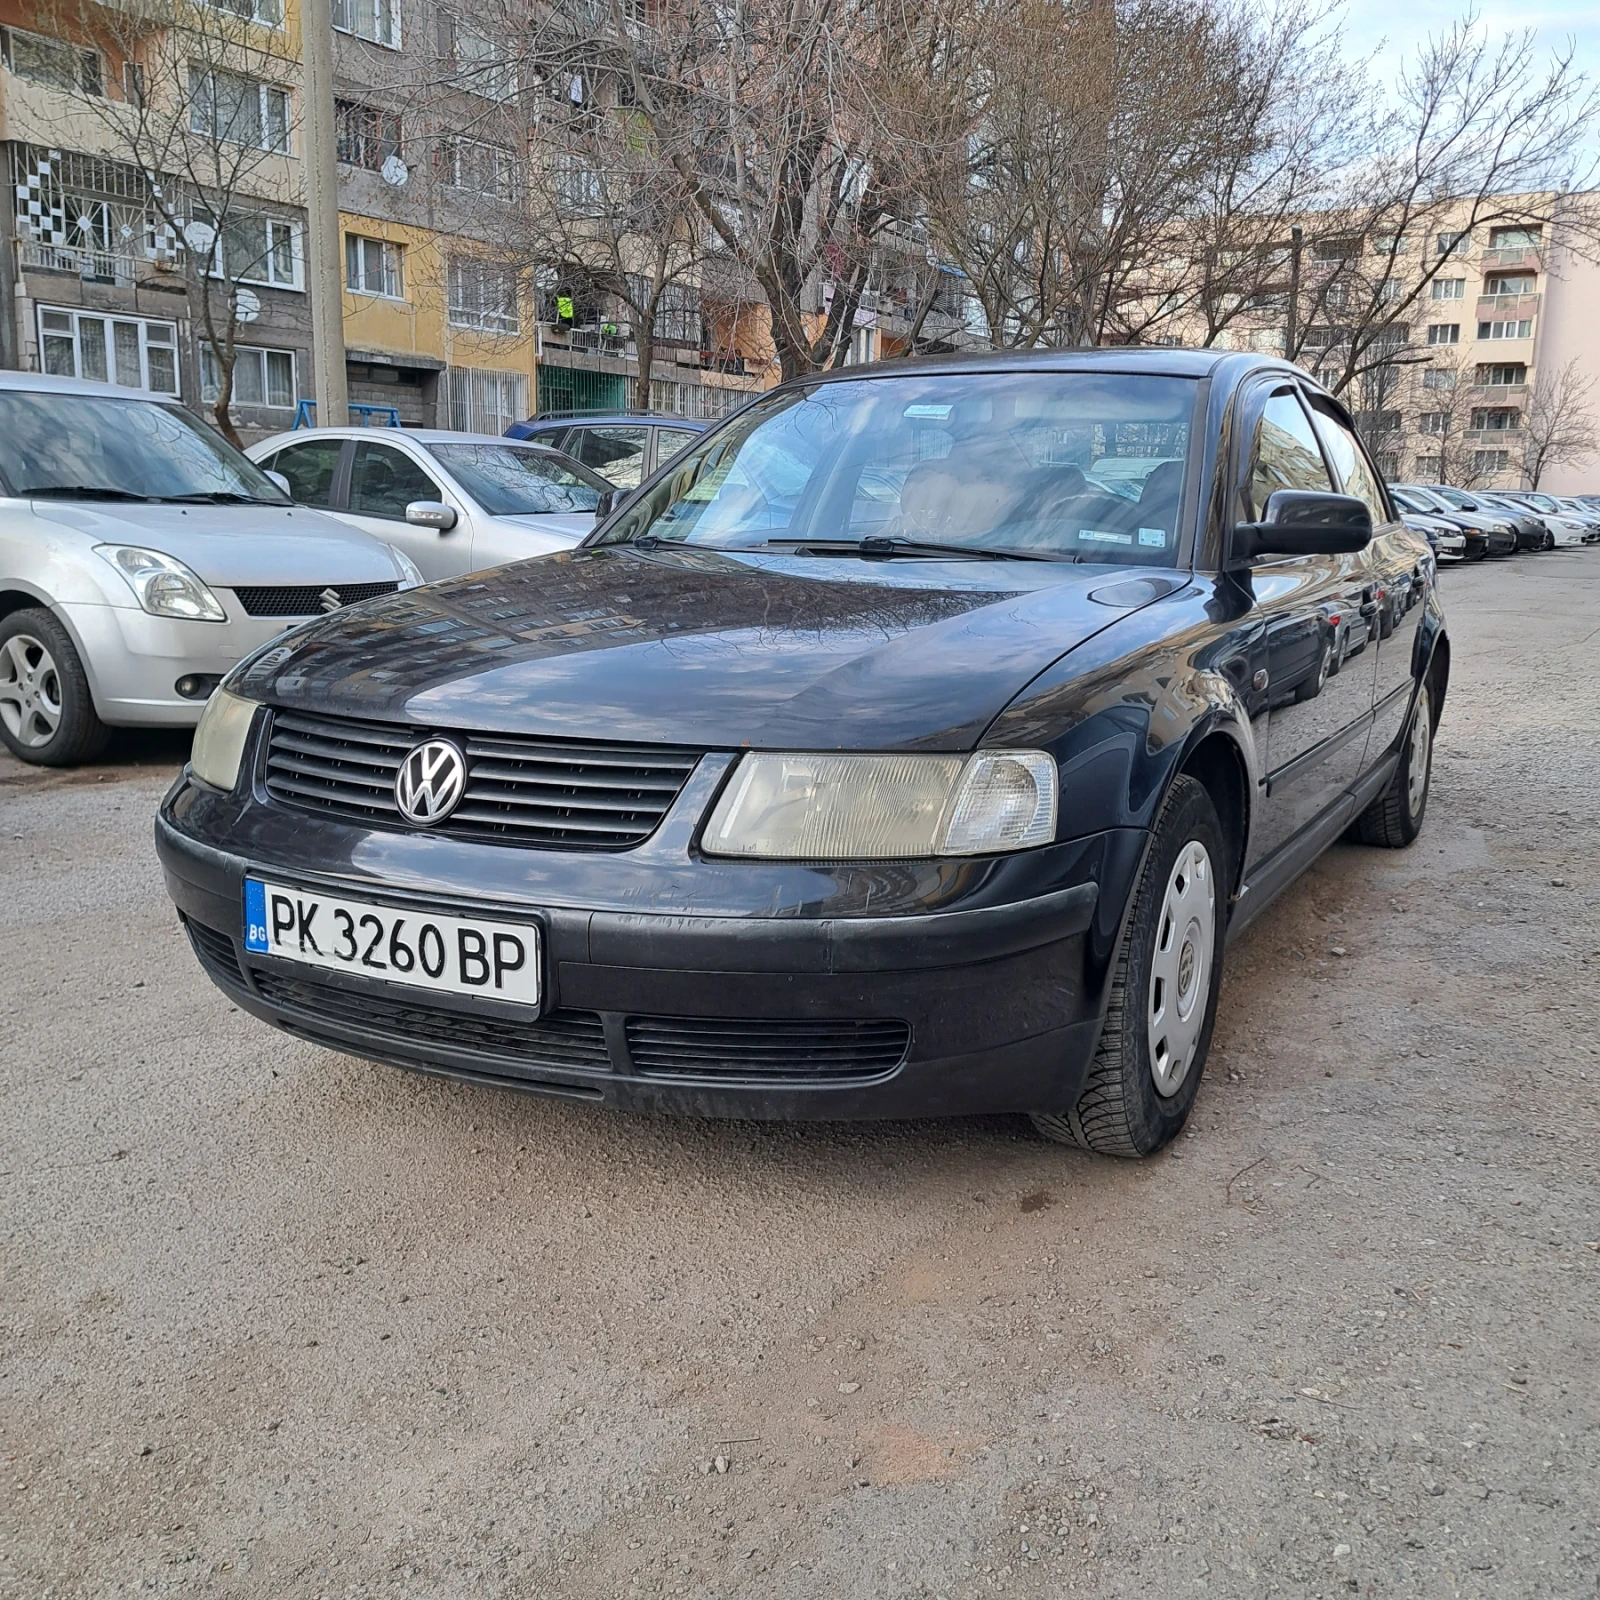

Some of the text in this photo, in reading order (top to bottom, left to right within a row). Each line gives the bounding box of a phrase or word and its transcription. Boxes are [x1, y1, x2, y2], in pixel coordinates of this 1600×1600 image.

[395, 738, 466, 825] VW
[249, 923, 267, 942] BG
[271, 894, 526, 989] PK 3260 BP
